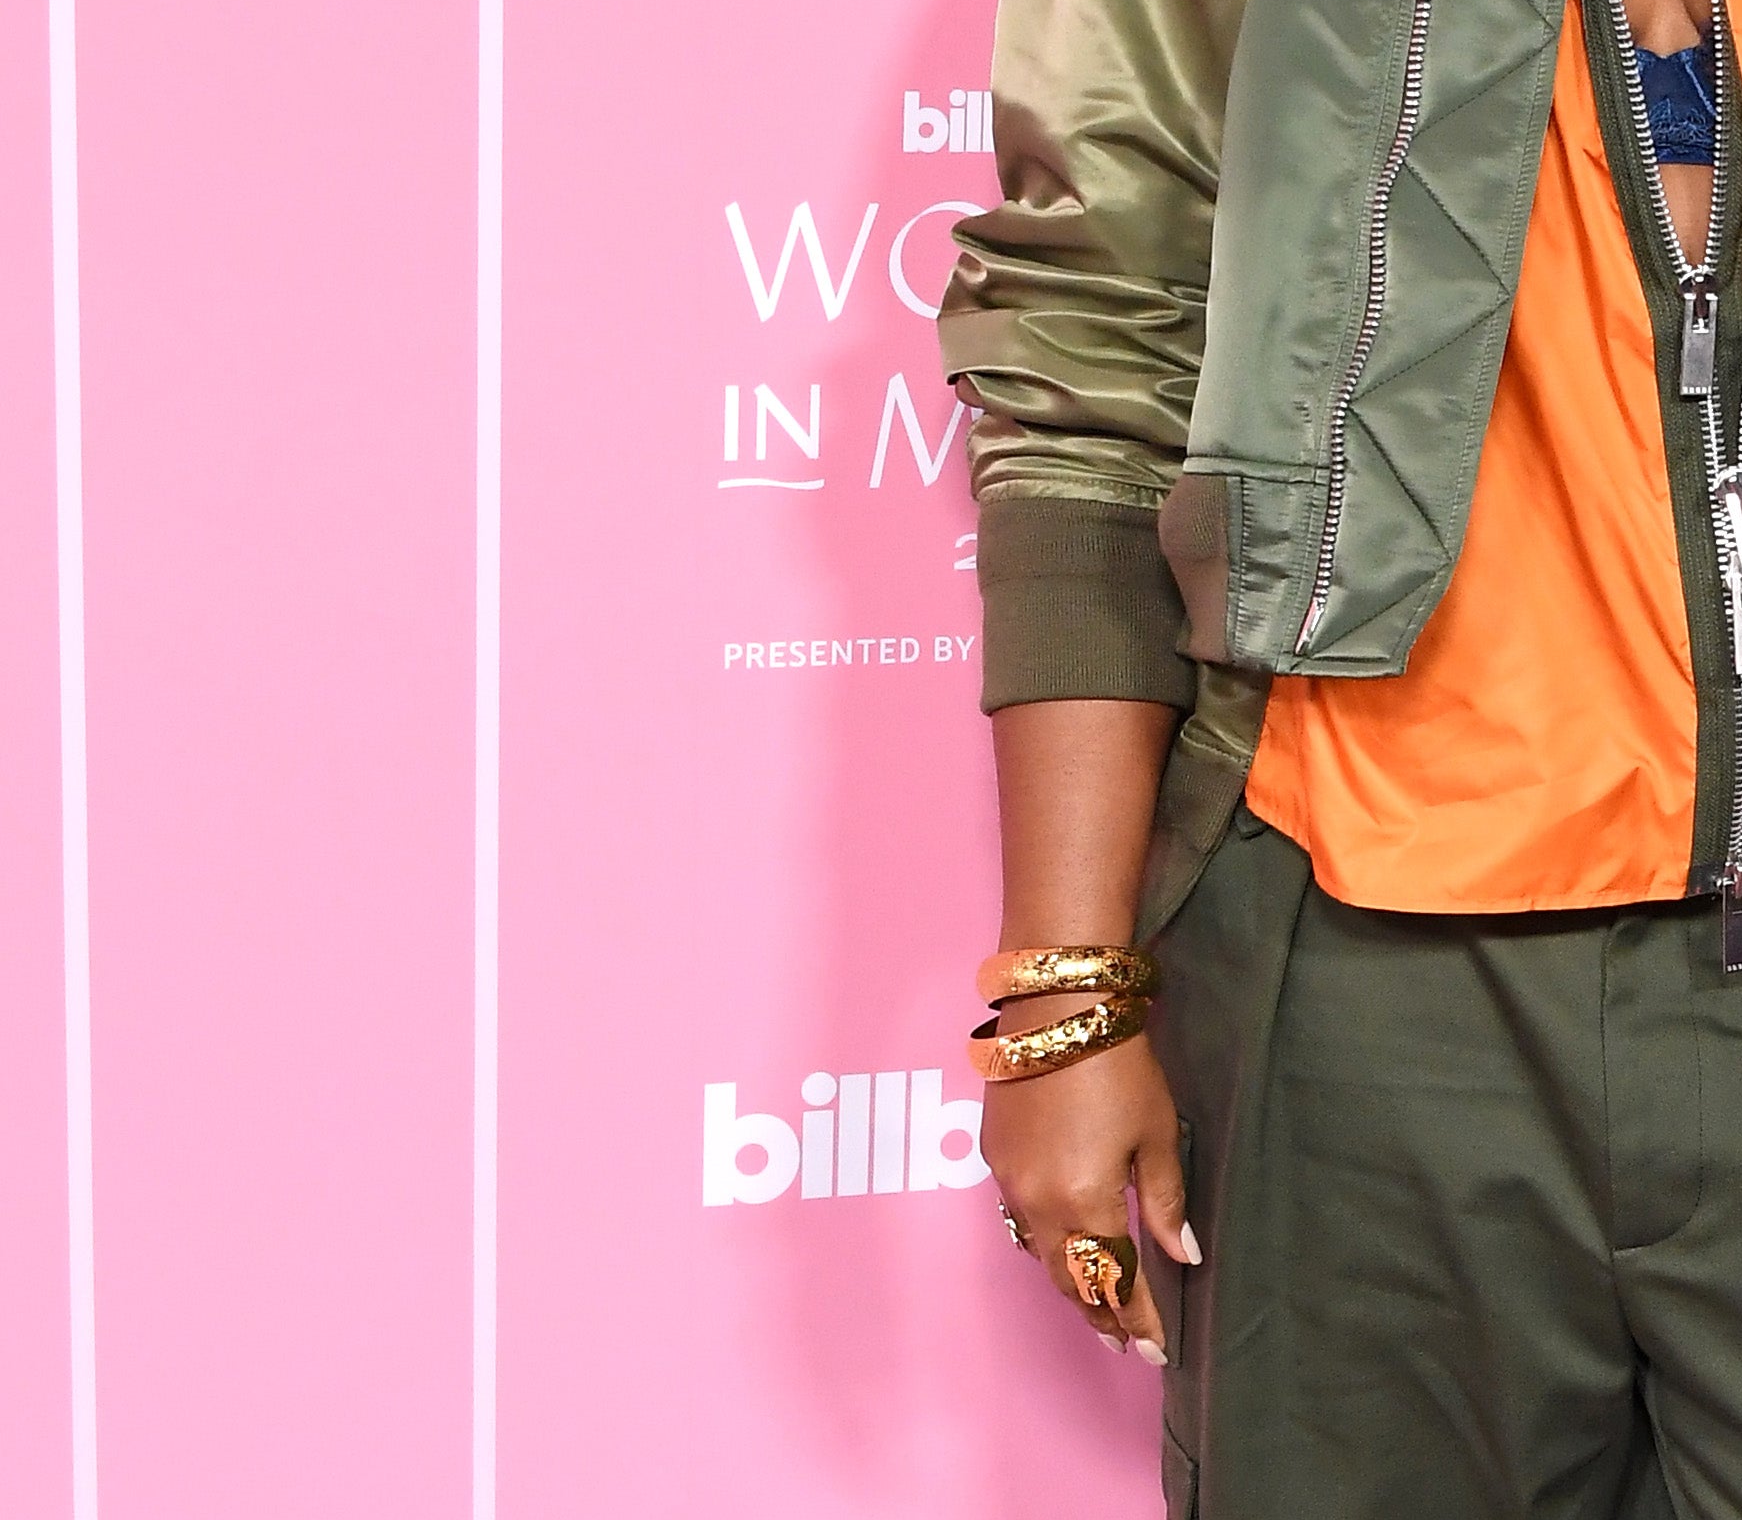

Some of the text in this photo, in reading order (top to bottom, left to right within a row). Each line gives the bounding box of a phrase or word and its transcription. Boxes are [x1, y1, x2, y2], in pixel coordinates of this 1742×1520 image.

[724, 383, 822, 462] IN
[724, 635, 975, 670] PRESENTED BY
[702, 1068, 992, 1208] billb
